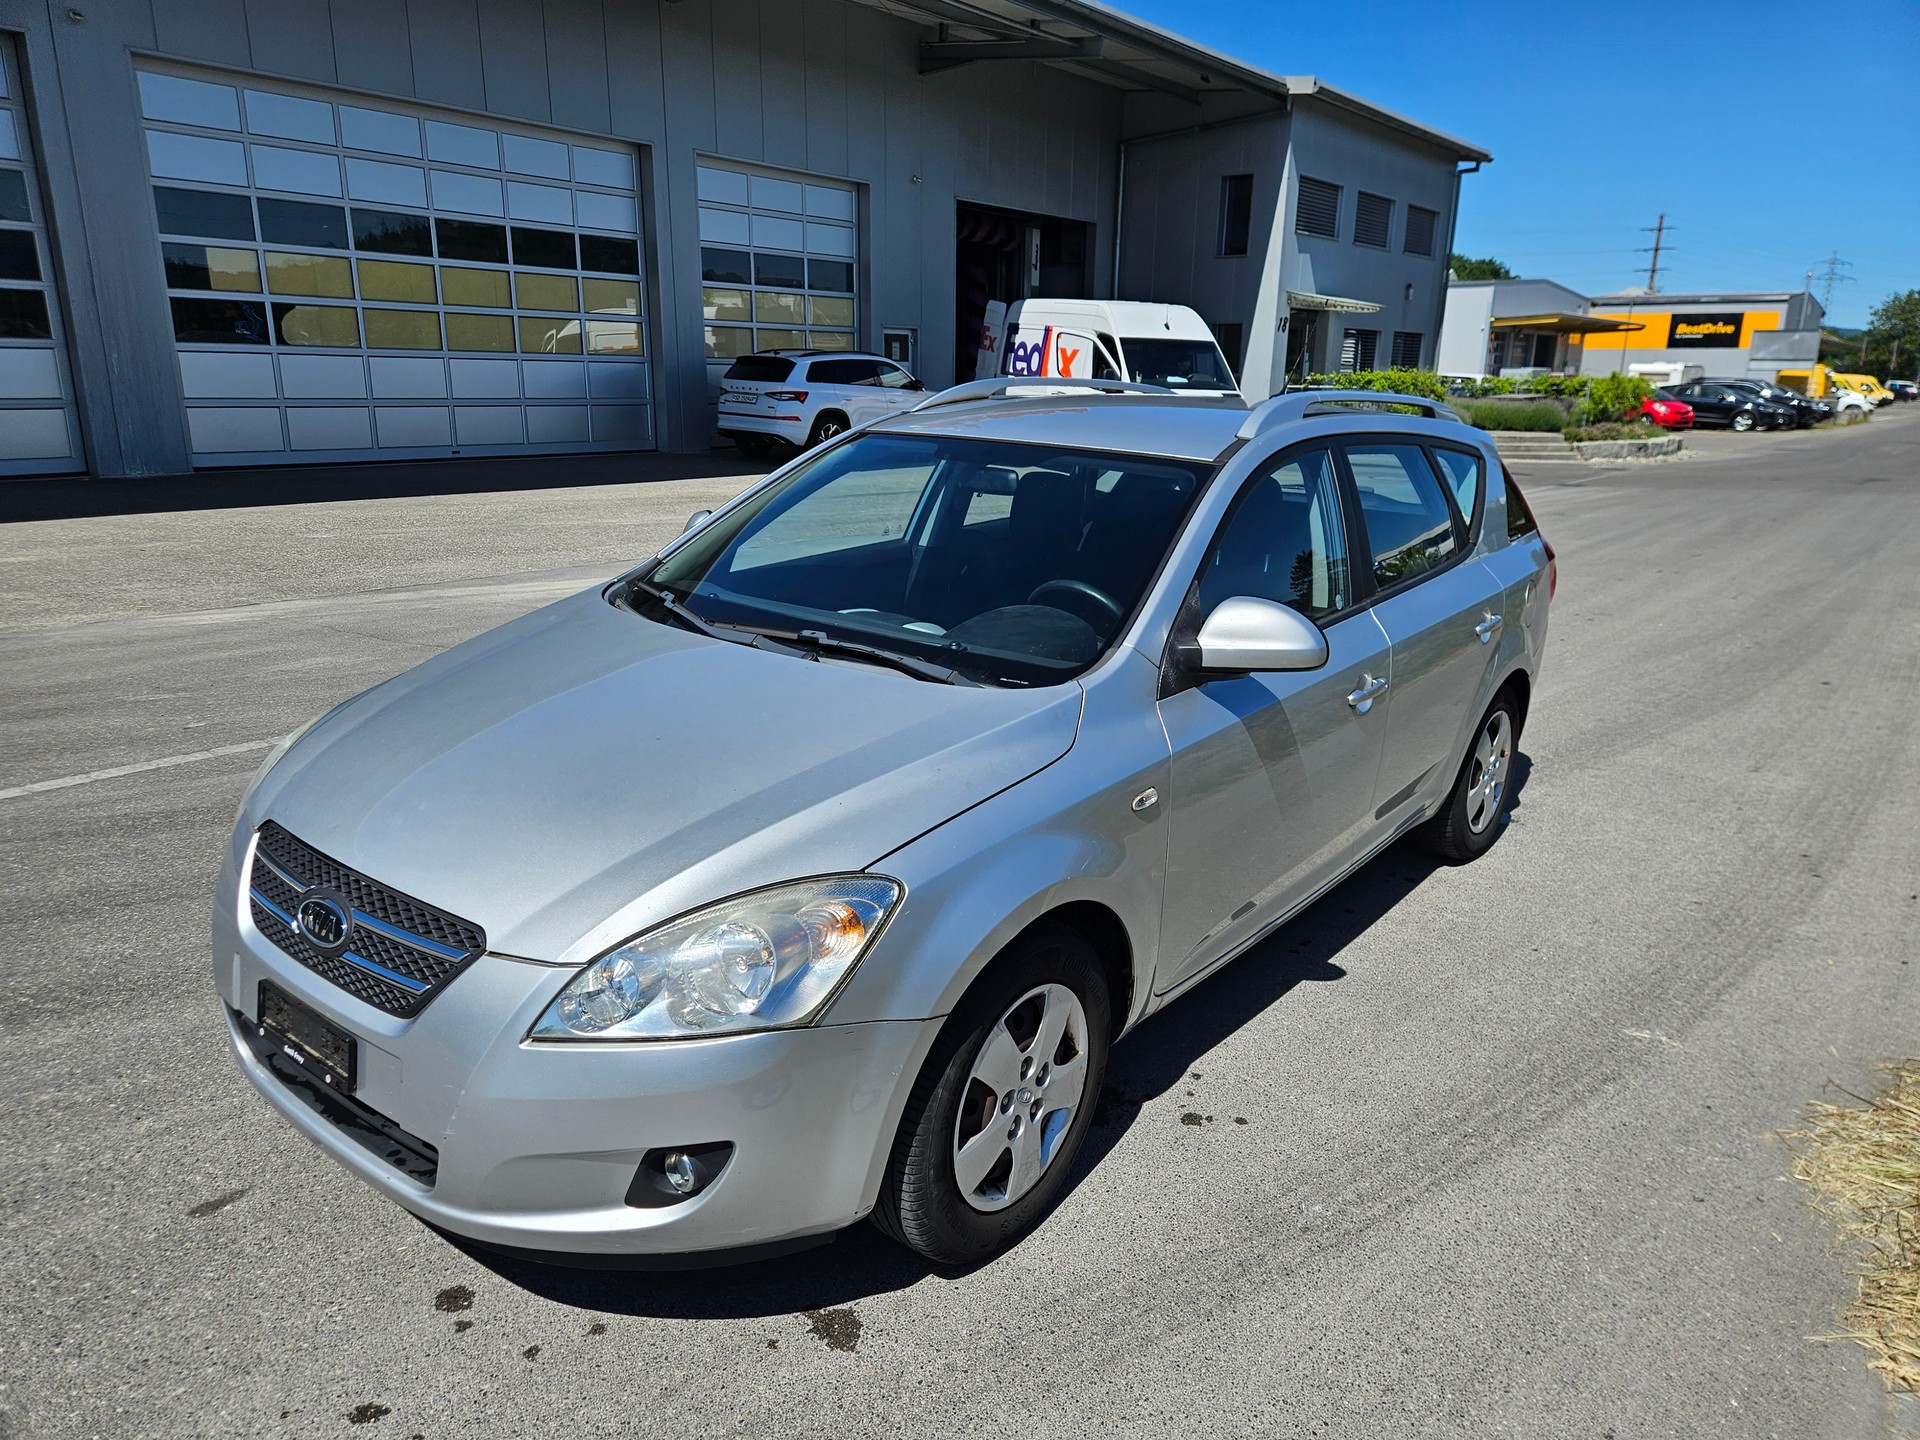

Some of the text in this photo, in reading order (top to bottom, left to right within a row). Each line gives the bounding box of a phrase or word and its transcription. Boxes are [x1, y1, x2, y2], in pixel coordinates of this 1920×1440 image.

[1277, 316, 1289, 333] 18
[1676, 321, 1735, 335] BestDrive
[304, 902, 337, 941] KIA
